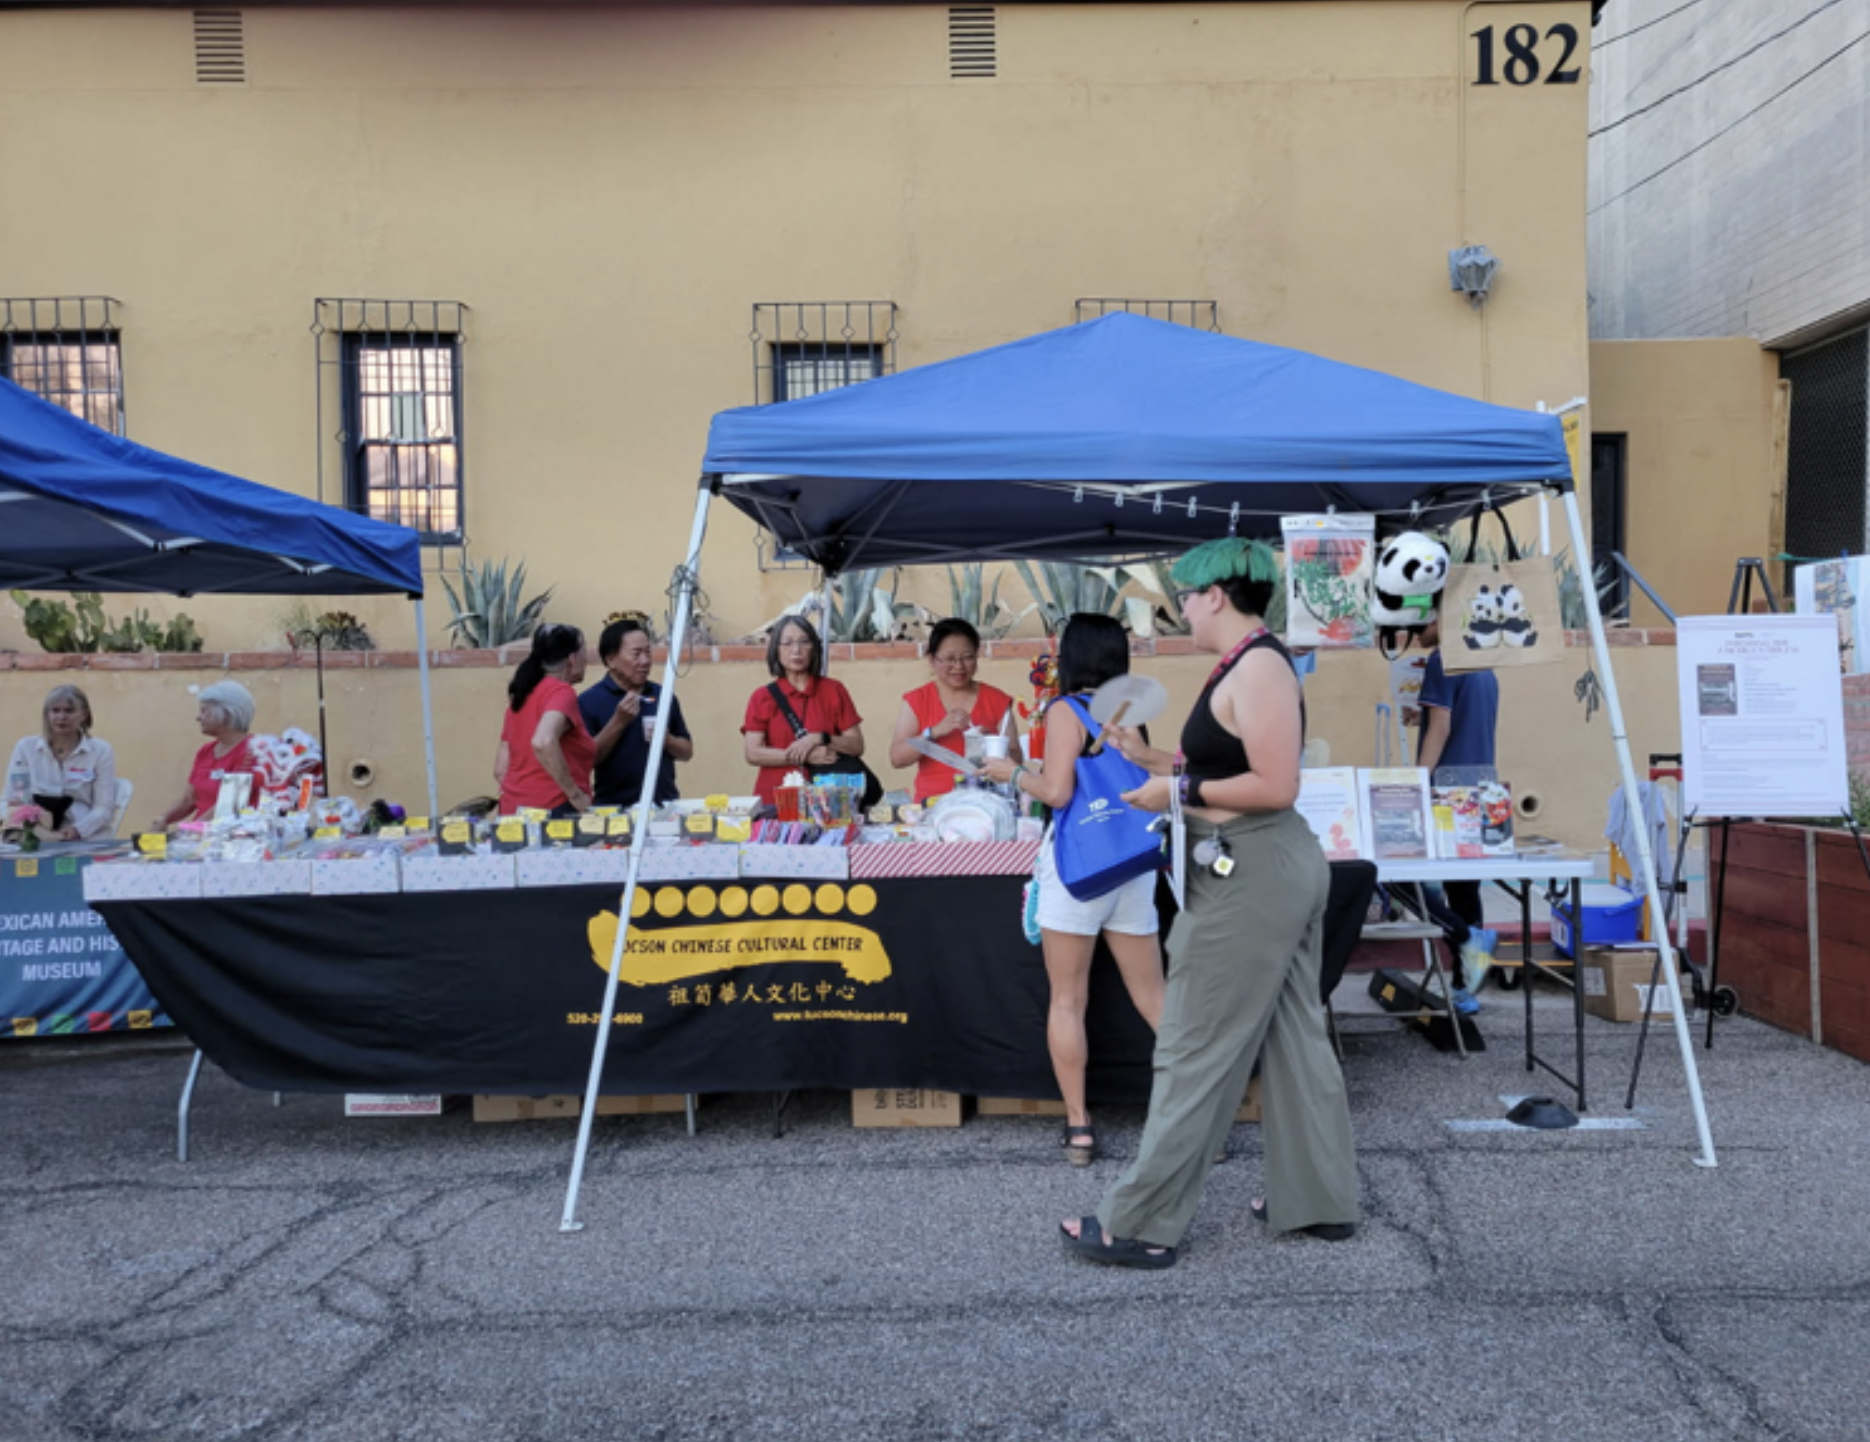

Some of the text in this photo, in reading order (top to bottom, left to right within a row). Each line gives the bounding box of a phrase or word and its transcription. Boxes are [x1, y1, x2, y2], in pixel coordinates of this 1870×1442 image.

[1470, 23, 1582, 86] 182
[48, 937, 85, 953] AND
[613, 936, 864, 954] UCSON CHINESE CULTURAL CENTER
[22, 961, 101, 980] MUSEUM
